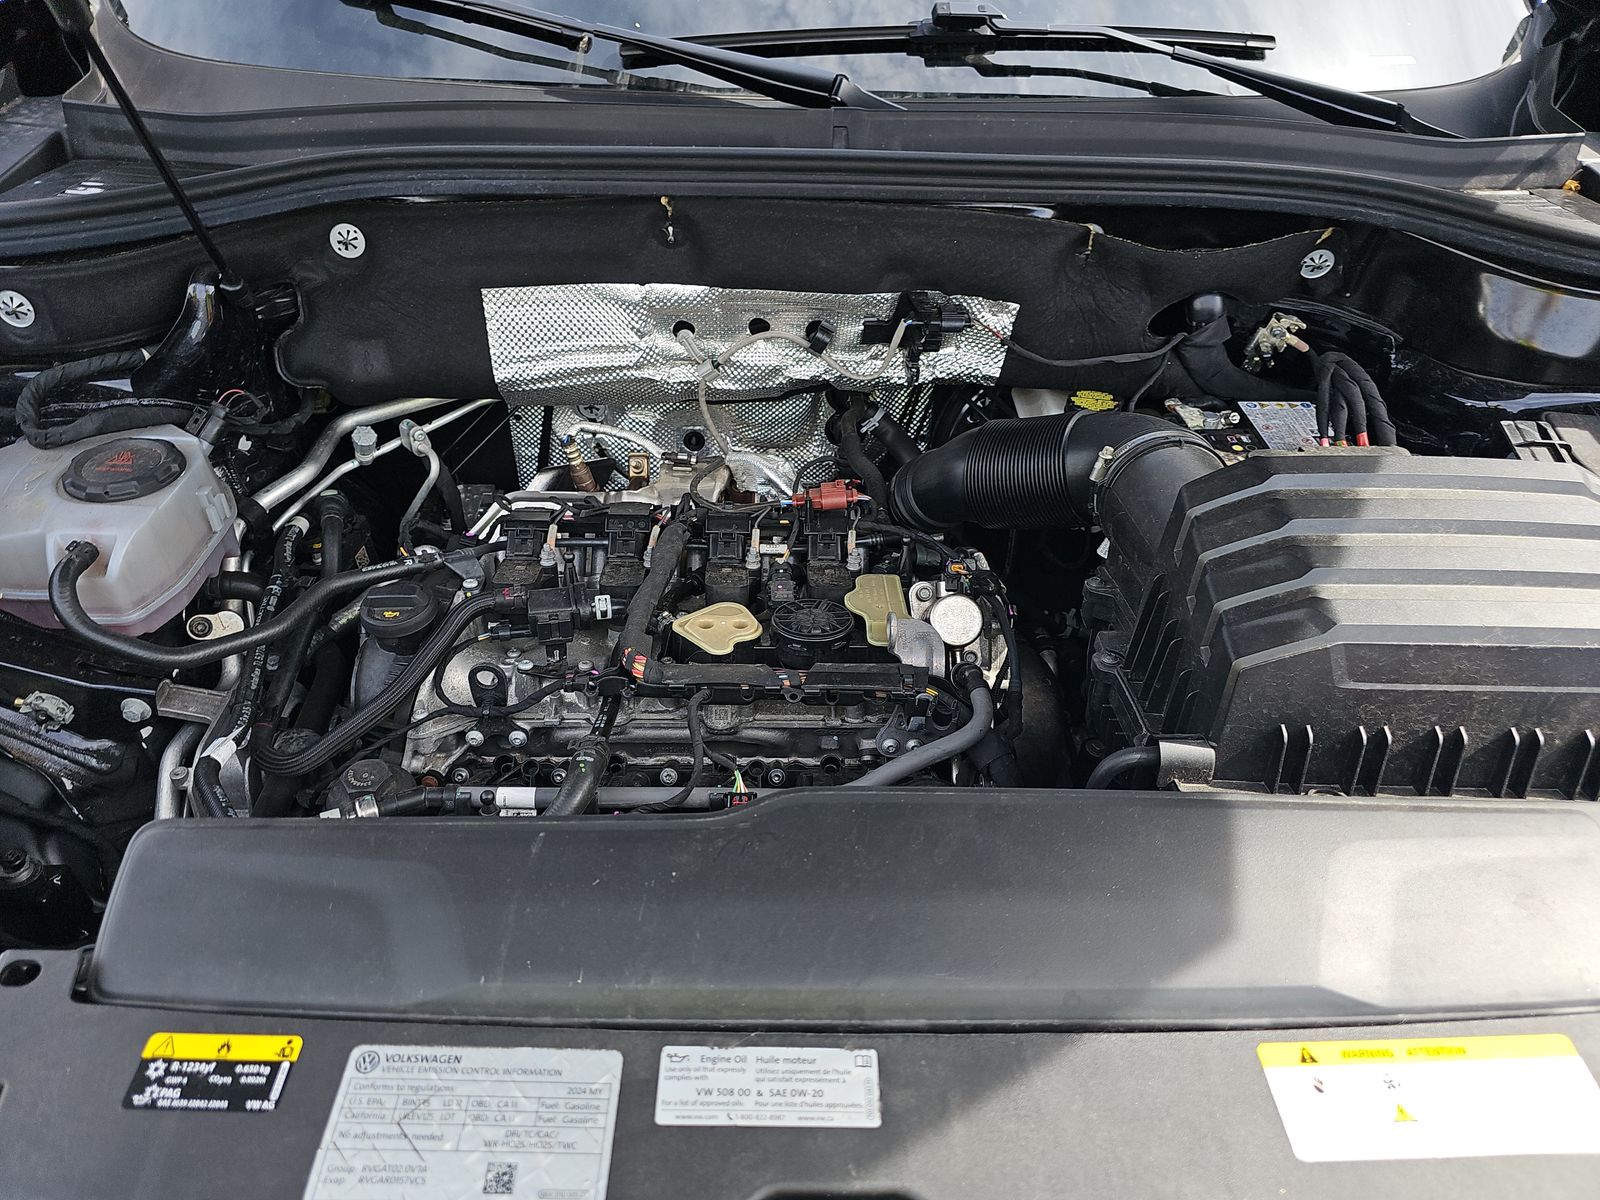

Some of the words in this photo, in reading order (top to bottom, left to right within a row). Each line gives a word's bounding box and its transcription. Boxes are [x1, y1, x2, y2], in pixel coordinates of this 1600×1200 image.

[384, 1053, 463, 1064] VOLKSWAGEN
[700, 1055, 732, 1065] Engine
[735, 1055, 748, 1063] Oil
[755, 1056, 780, 1064] Huile
[170, 1061, 217, 1074] R-1234yf
[260, 1064, 271, 1076] kg
[381, 1066, 416, 1074] VEHICLE
[417, 1066, 460, 1075] EMISSION
[461, 1067, 500, 1076] CONTROL
[502, 1068, 563, 1077] INFORMATION
[160, 1087, 182, 1098] PAG
[353, 1082, 394, 1092] Conforms
[396, 1083, 405, 1092] to
[407, 1083, 455, 1094] regulations
[567, 1087, 588, 1096] 2024
[696, 1087, 714, 1096] VW
[716, 1088, 735, 1097] 508
[737, 1088, 751, 1097] 00
[756, 1089, 763, 1097] &
[769, 1088, 788, 1097] SAE
[790, 1088, 824, 1098] 0W-20
[245, 1100, 261, 1110] VW
[261, 1101, 276, 1110] AG
[565, 1101, 600, 1111] Gasoline
[562, 1114, 598, 1124] Gasoline
